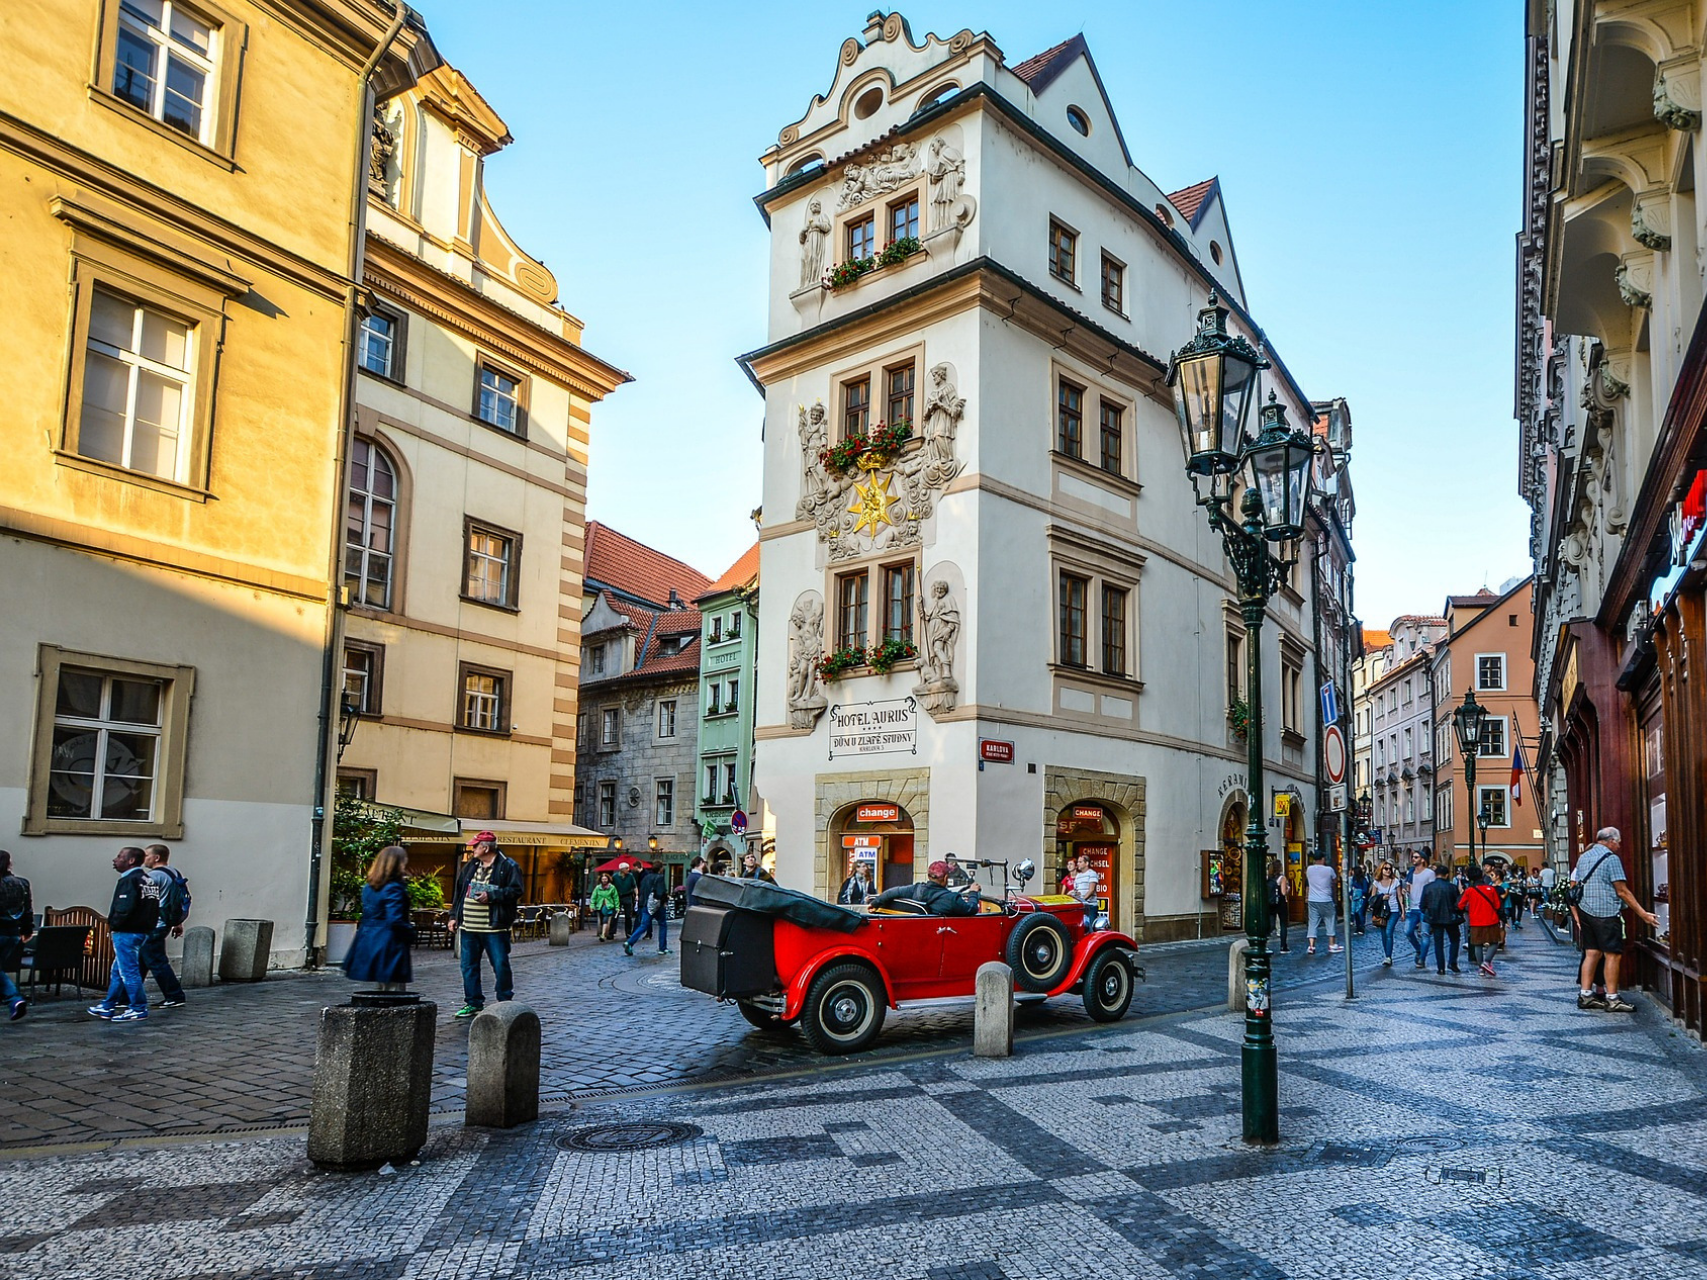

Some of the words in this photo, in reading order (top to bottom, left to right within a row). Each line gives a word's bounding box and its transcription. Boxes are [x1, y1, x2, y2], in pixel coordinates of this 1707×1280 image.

[715, 652, 737, 664] HOTEL
[837, 712, 870, 727] HOTEL
[872, 709, 909, 724] AURUS
[833, 736, 850, 748] DŮM
[851, 737, 857, 747] U
[857, 733, 881, 746] ZLATÉ
[882, 732, 913, 744] STUDNY
[986, 744, 1009, 753] KARLOVA
[1217, 773, 1249, 798] KERAMI
[859, 808, 896, 818] change
[1075, 809, 1101, 817] CHANGE
[497, 836, 547, 844] RESTAURANT
[560, 838, 600, 846] CLEMENTIN
[853, 837, 870, 846] ATM
[1082, 847, 1108, 855] CHANGE
[1090, 860, 1109, 868] CHSEL
[1095, 884, 1108, 892] BIO
